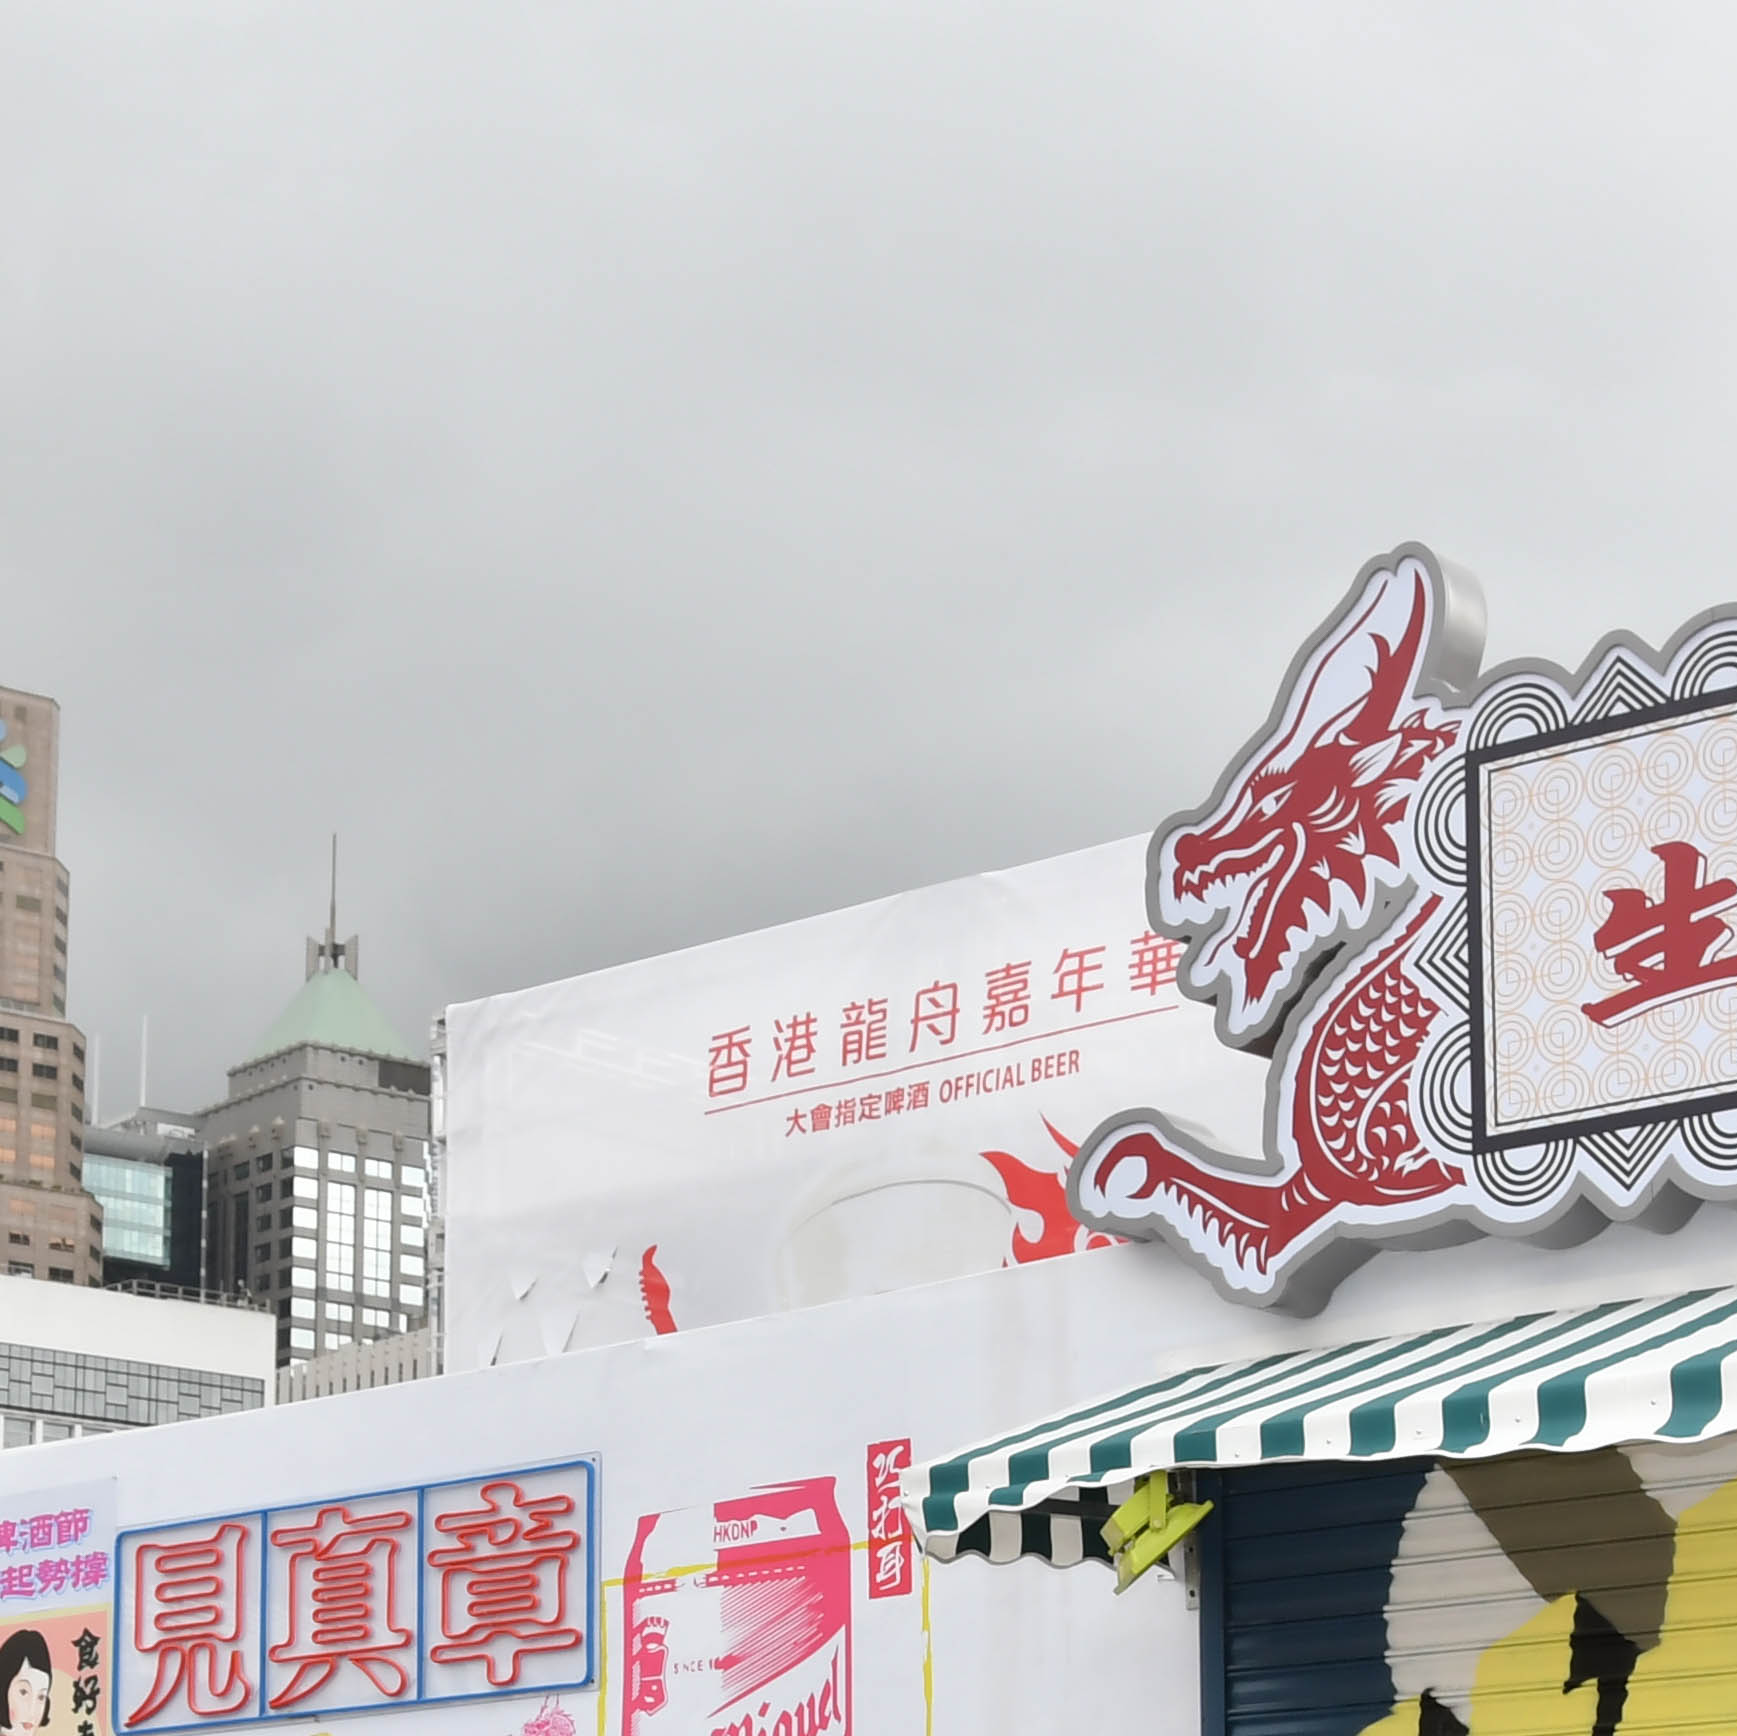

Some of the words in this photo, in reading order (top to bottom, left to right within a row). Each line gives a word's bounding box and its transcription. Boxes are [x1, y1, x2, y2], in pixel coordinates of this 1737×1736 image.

[708, 930, 1180, 1099] 香港龍舟嘉年華
[785, 1080, 930, 1138] 大會指定啤酒
[939, 1061, 1026, 1105] OFFICIAL
[1031, 1049, 1081, 1083] BEER
[126, 1481, 584, 1727] 見真章
